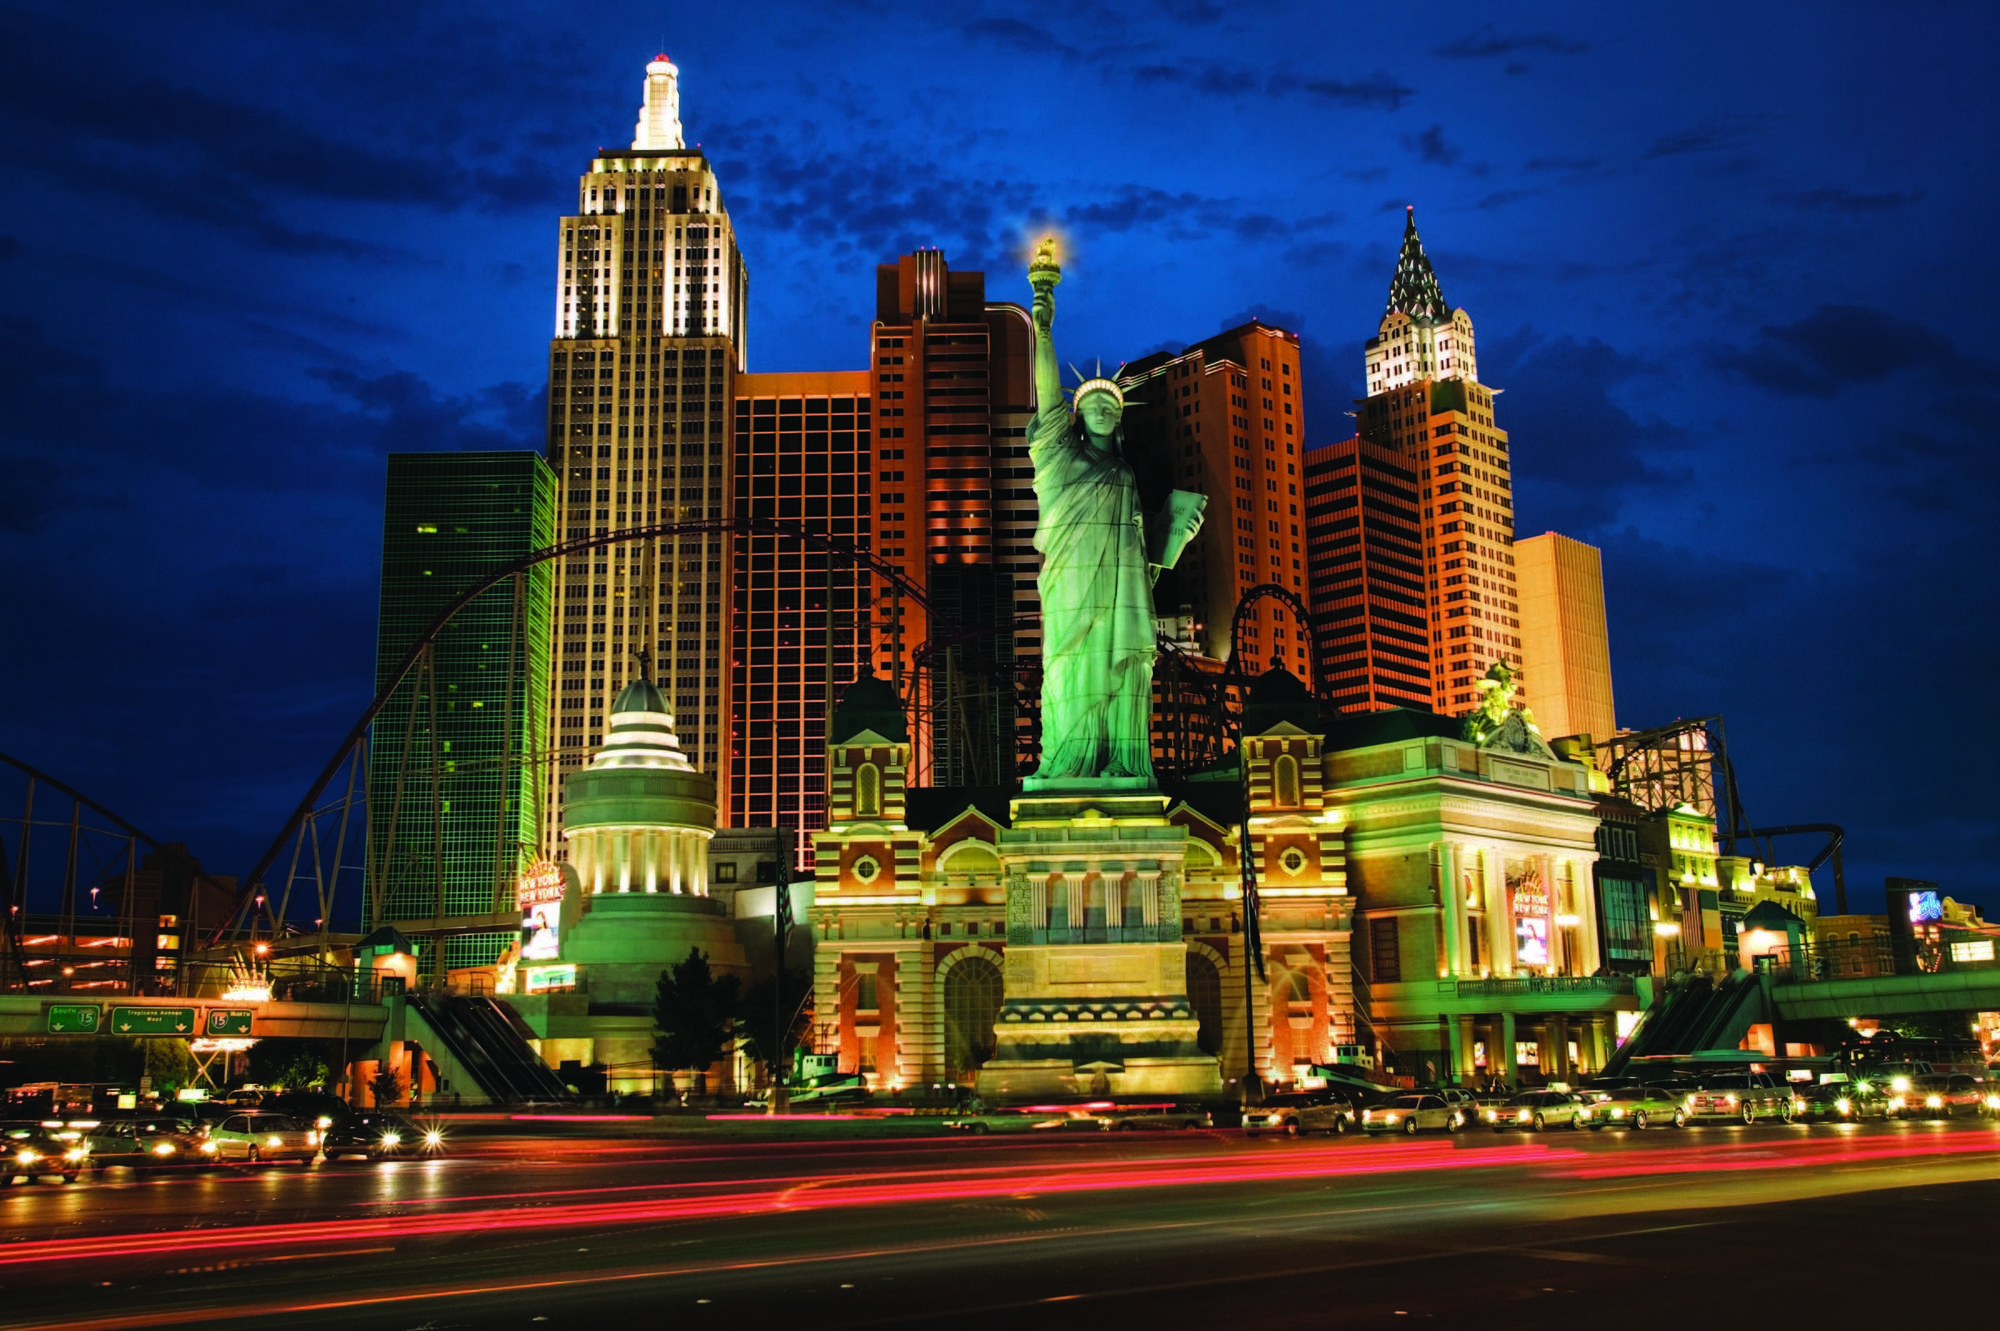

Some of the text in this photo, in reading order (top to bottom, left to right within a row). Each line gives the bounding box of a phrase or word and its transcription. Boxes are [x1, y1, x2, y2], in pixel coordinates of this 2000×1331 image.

[538, 874, 560, 887] YORK
[538, 887, 561, 899] YORK
[1514, 893, 1549, 905] NEW YORK
[1514, 903, 1549, 914] NEW YORK
[80, 1013, 93, 1023] 15
[212, 1015, 226, 1025] 15
